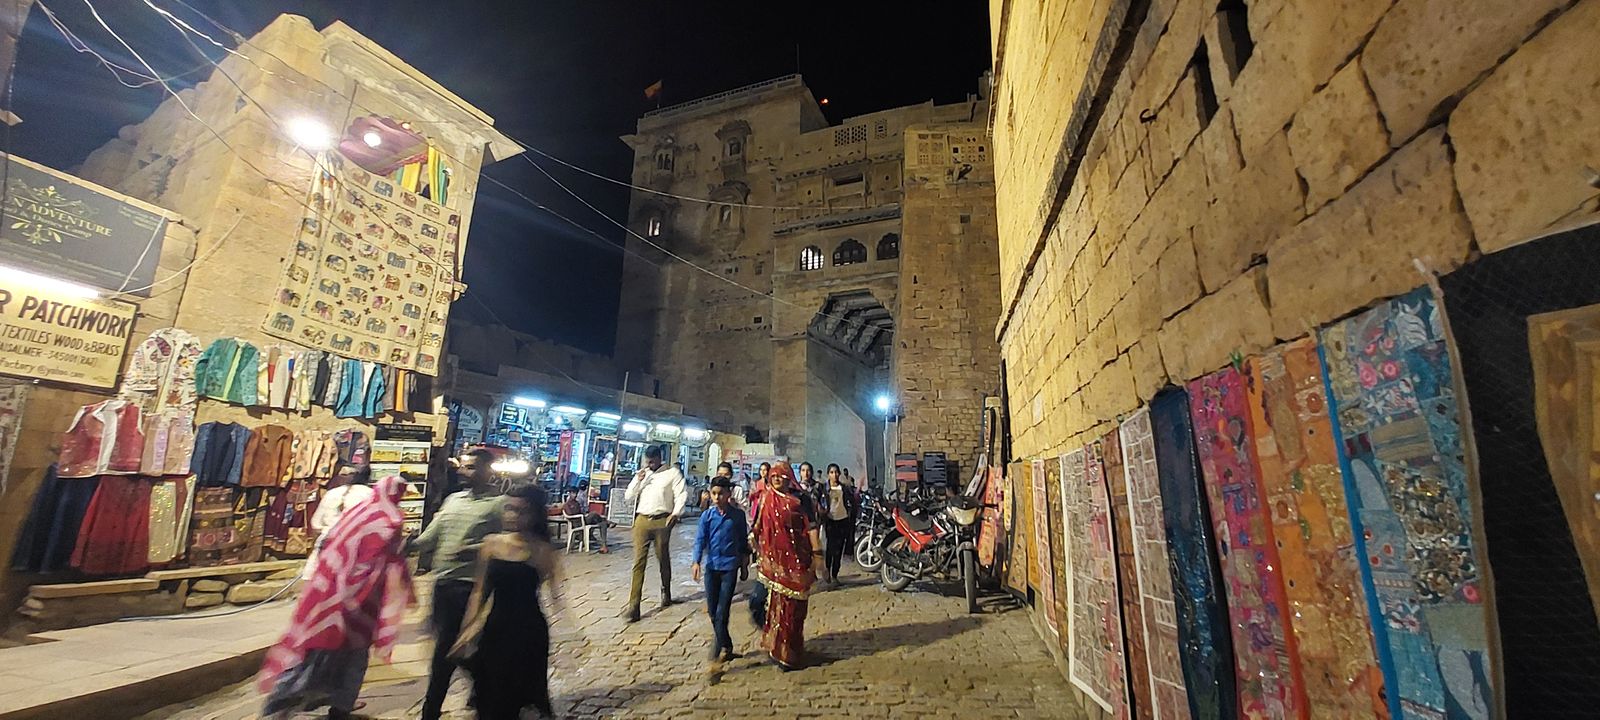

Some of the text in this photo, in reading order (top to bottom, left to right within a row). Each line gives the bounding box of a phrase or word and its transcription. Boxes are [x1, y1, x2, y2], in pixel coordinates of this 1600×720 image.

[27, 203, 113, 237] ADVENTURE
[18, 296, 132, 338] PATCHWORK
[1, 324, 52, 345] TEXTILES
[53, 334, 84, 350] WOOD
